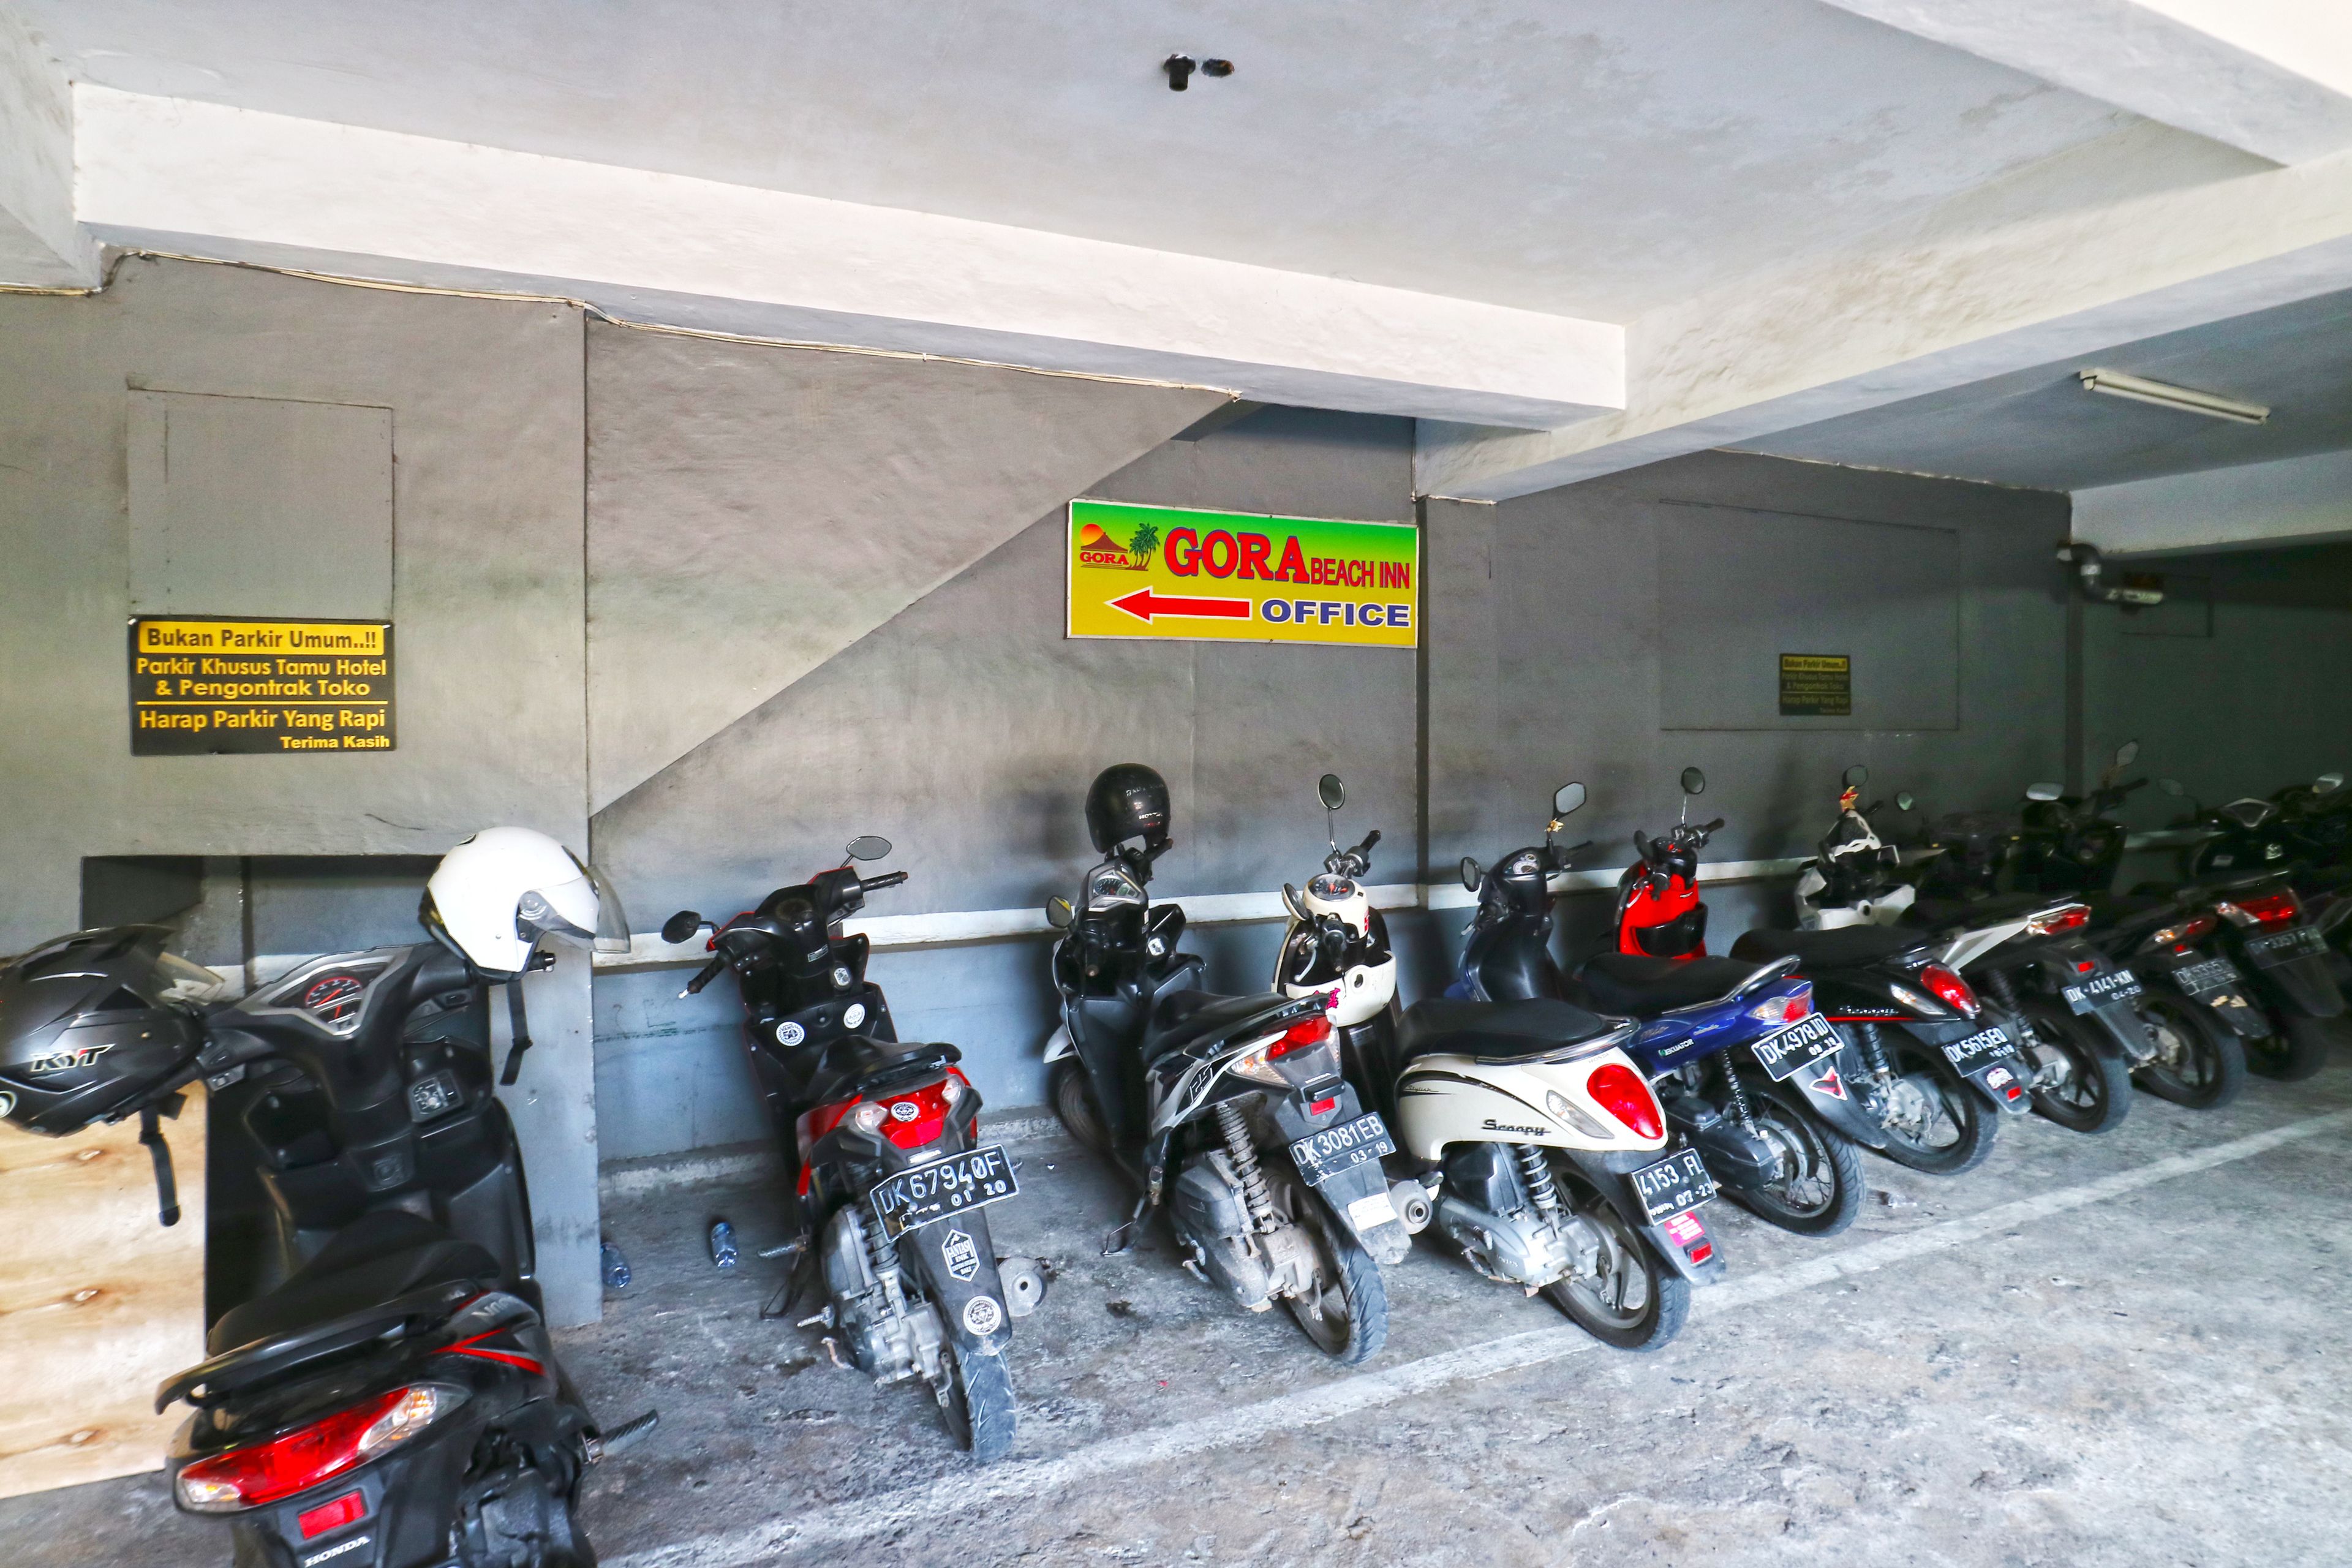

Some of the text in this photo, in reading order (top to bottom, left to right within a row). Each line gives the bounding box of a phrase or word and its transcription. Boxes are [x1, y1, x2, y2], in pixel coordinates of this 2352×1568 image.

[1079, 552, 1129, 566] GORA
[1164, 527, 1409, 589] GORA BEACH INN
[1260, 598, 1411, 628] OFFICE
[148, 628, 376, 649] Bukan Parkir Umum..!!
[136, 658, 386, 676] Parkir Khusus Tamu Hotel
[156, 679, 370, 699] & Pengontrak Toko
[140, 709, 385, 732] Harap Parkir Yang Rapi
[280, 735, 390, 748] Terima Kasih
[783, 1030, 797, 1040] 50
[29, 1044, 116, 1072] KYT
[1189, 1063, 1213, 1105] 125
[1481, 1119, 1551, 1136] Scoopy
[1640, 1155, 1704, 1195] 4153 FL
[984, 1179, 1006, 1196] 20
[304, 1536, 371, 1568] HONDA
